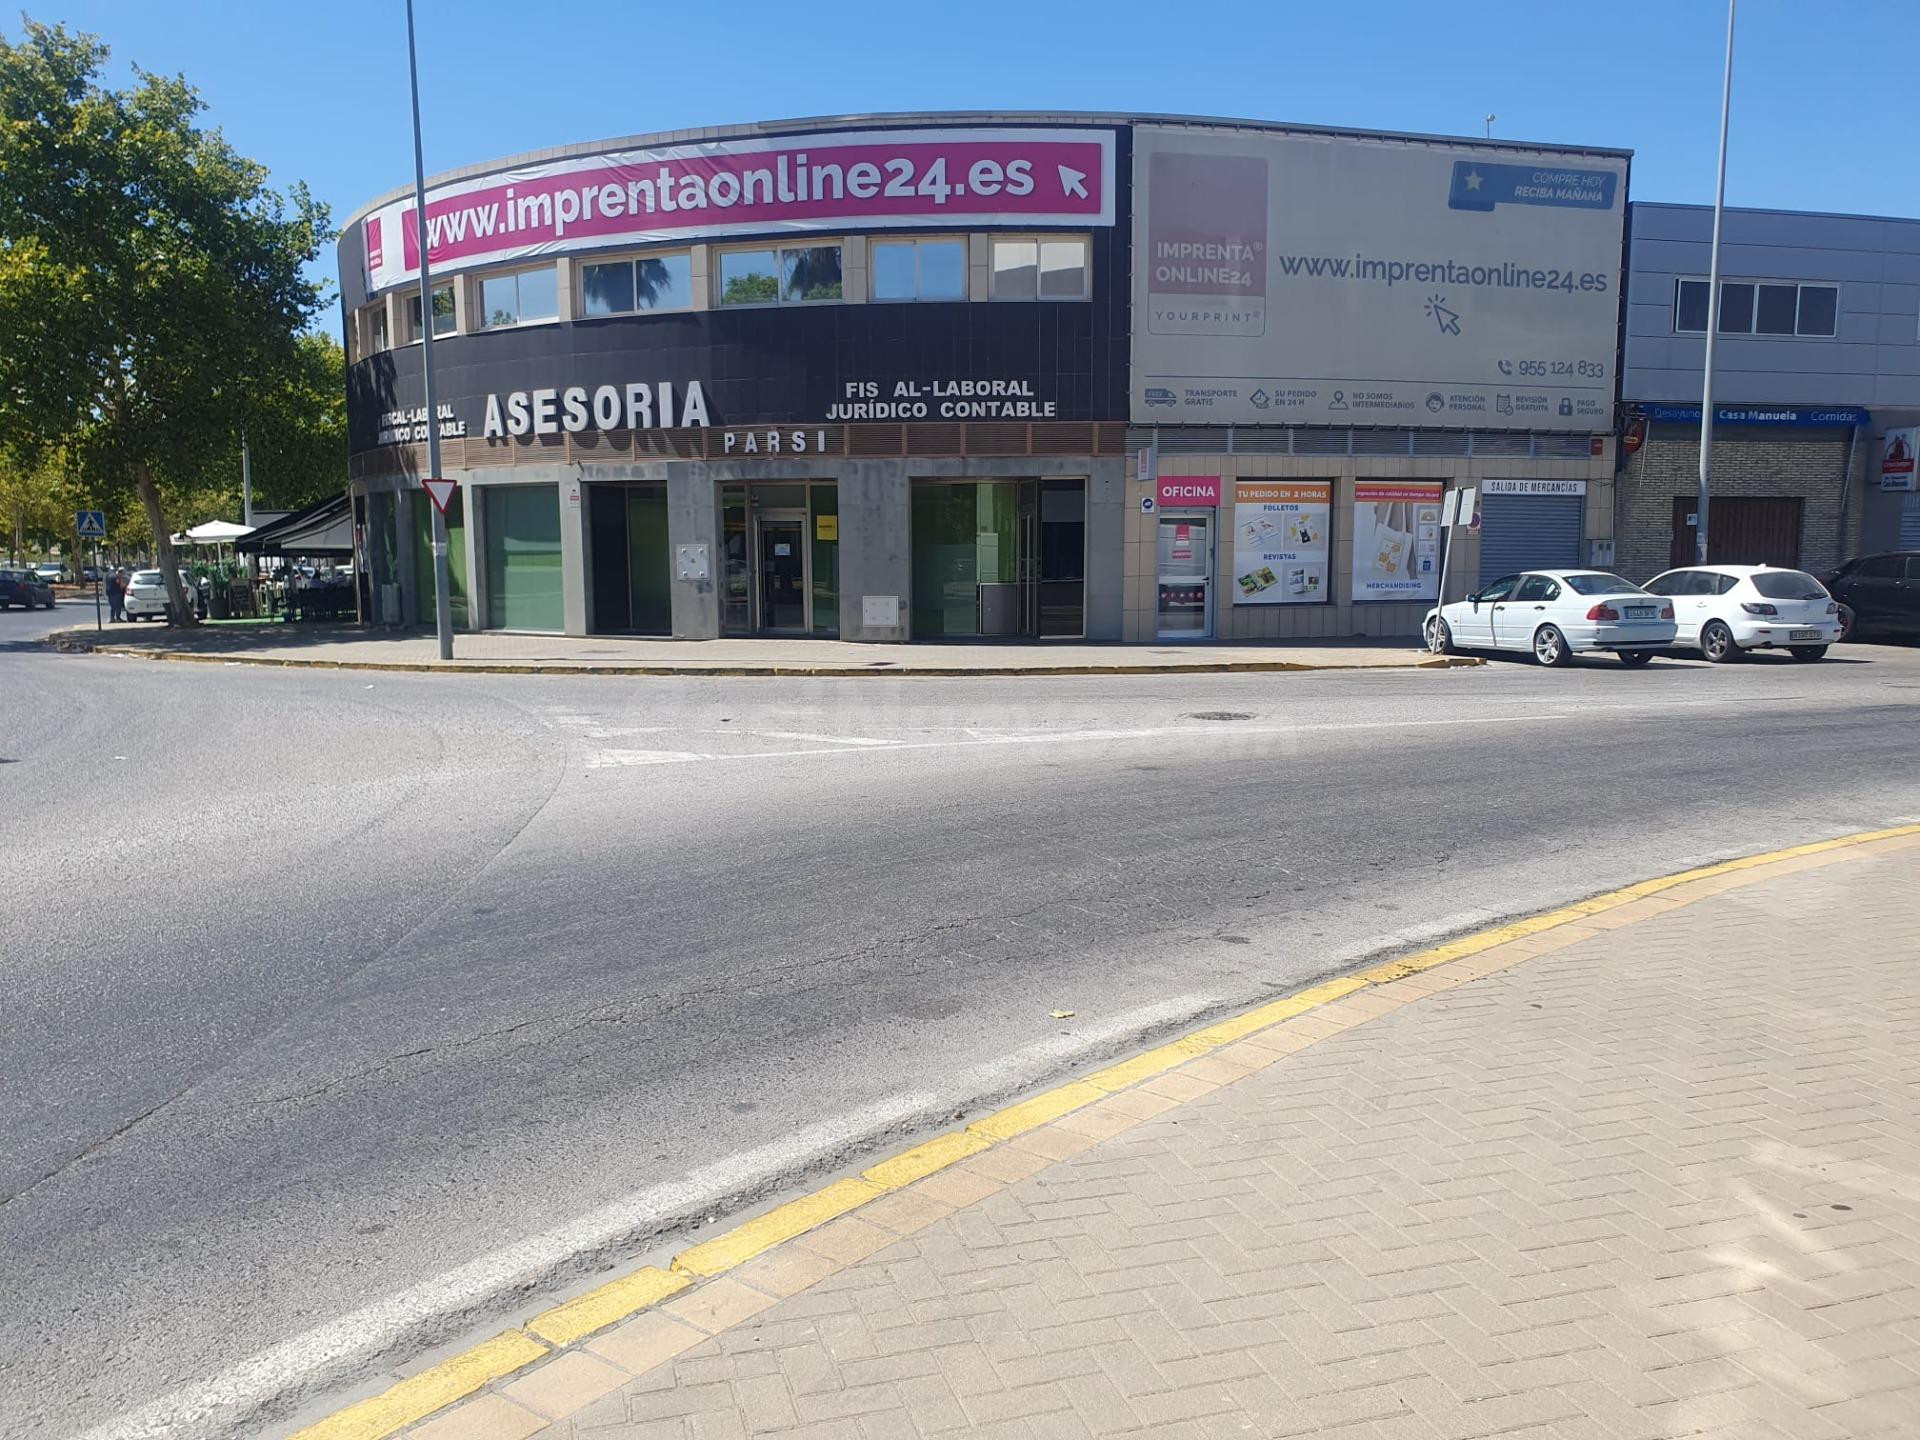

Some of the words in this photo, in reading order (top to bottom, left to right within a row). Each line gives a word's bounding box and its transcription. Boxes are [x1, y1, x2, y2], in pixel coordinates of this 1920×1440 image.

[1532, 171, 1579, 186] COMPRE
[1581, 174, 1606, 187] HOY
[425, 153, 1034, 248] www.imprentaonline24.es
[1514, 185, 1553, 198] RECIBA
[1556, 186, 1603, 202] MAÑANA
[1156, 265, 1252, 287] ONLINE24
[1279, 253, 1608, 293] www.imprentaonline24.es
[1518, 360, 1546, 377] 955
[1550, 361, 1574, 377] 124
[1577, 360, 1604, 378] 833
[845, 382, 879, 398] FIS
[893, 380, 1034, 397] AL-LABORAL
[1184, 389, 1238, 398] TRANSPORTE
[1275, 390, 1286, 398] SU
[1287, 390, 1317, 398] PEDIDO
[1352, 392, 1364, 400] NO
[1366, 392, 1393, 400] SOMOS
[484, 380, 710, 438] ASESORIA
[826, 400, 927, 420] JURÍDICO
[940, 401, 1056, 418] CONTABLE
[1352, 400, 1415, 409] INTERMEDIARIOS
[1450, 403, 1486, 412] PERSONAL
[1516, 404, 1548, 412] GRATUITA
[1719, 409, 1745, 420] Casa
[1748, 409, 1797, 421] Manuela
[415, 420, 466, 439] COABLE
[724, 430, 826, 454] PARSI
[1162, 486, 1215, 497] OFICINA
[1238, 490, 1248, 498] TU
[1250, 490, 1279, 498] PEDIDO
[1280, 490, 1290, 498] EN
[1491, 481, 1516, 492] SALIDA
[1519, 482, 1528, 492] DE
[1531, 481, 1577, 493] MERCANCÍAS
